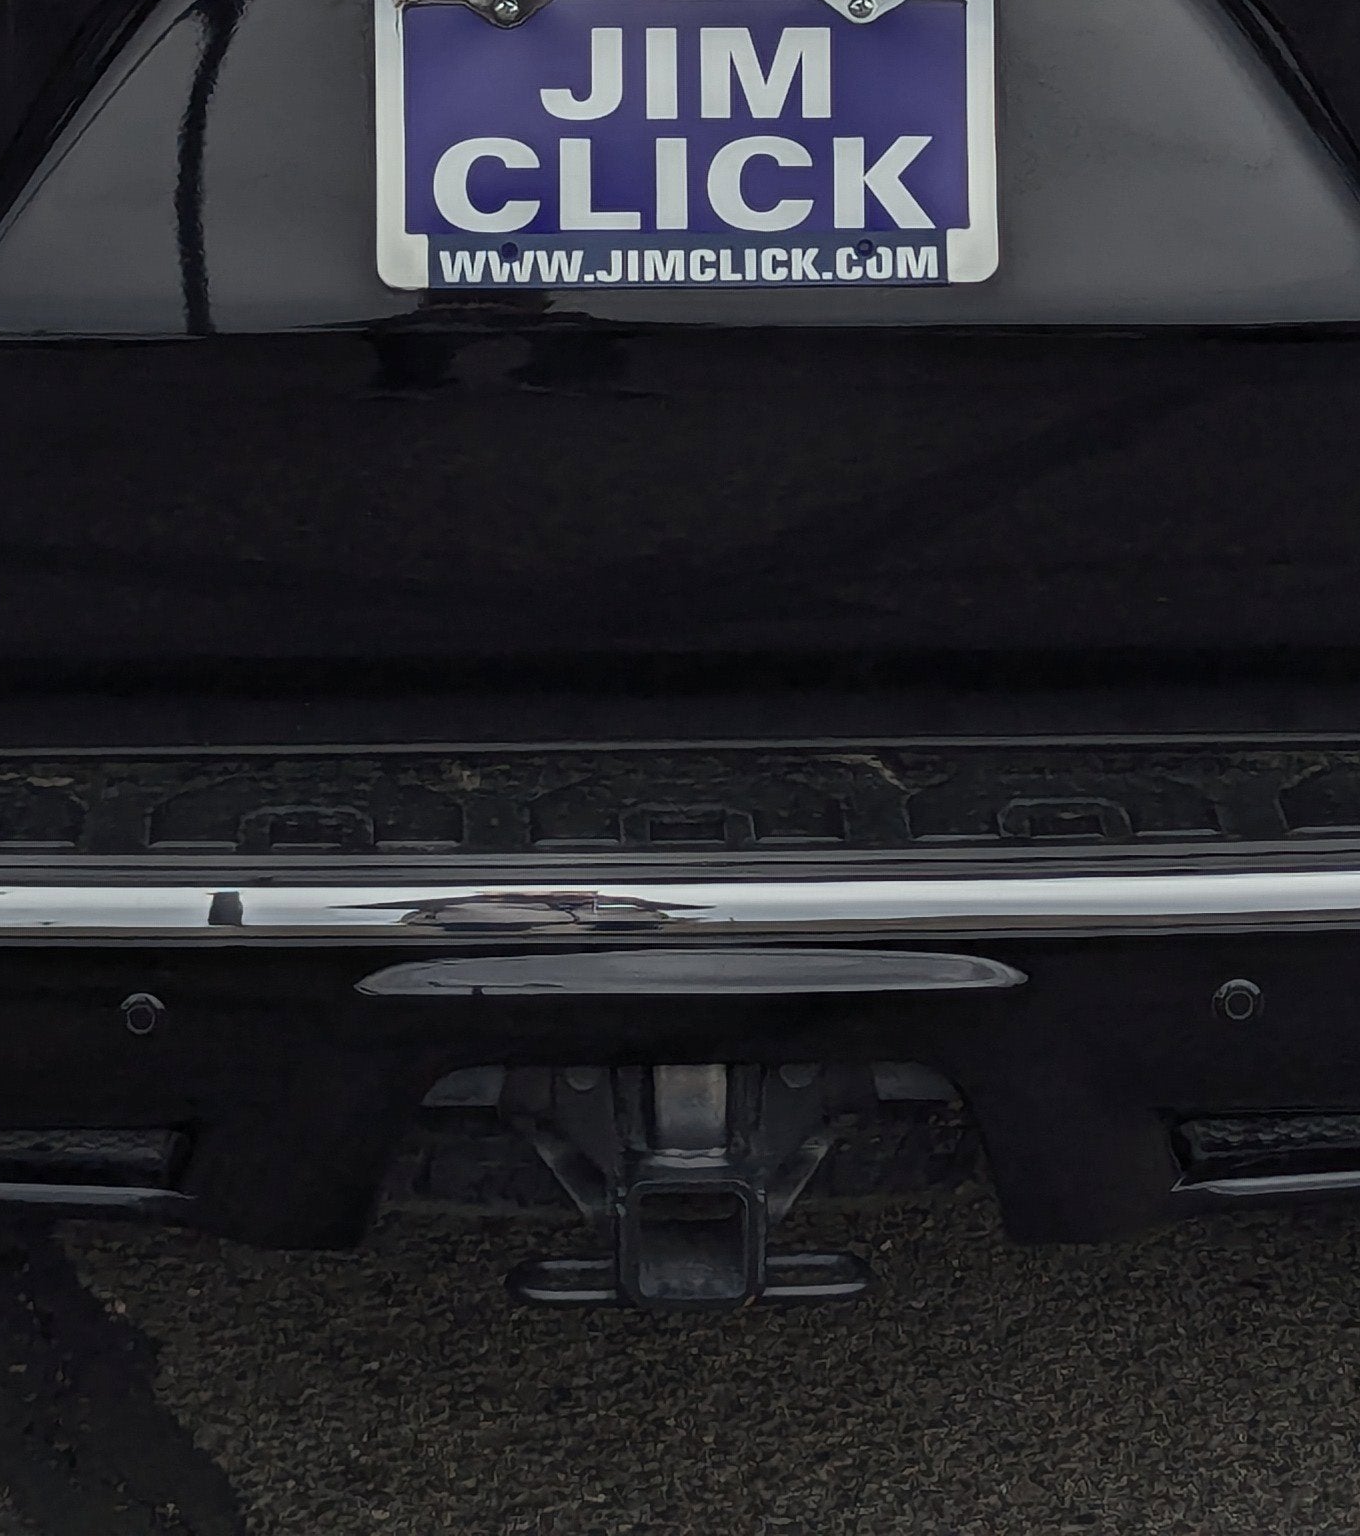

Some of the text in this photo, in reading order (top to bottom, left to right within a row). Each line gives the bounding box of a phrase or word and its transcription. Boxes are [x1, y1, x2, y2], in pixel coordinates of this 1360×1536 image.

[540, 26, 831, 121] JIM
[433, 135, 937, 233] CLICK
[439, 246, 939, 283] WWW.JIMCLICK.COM
